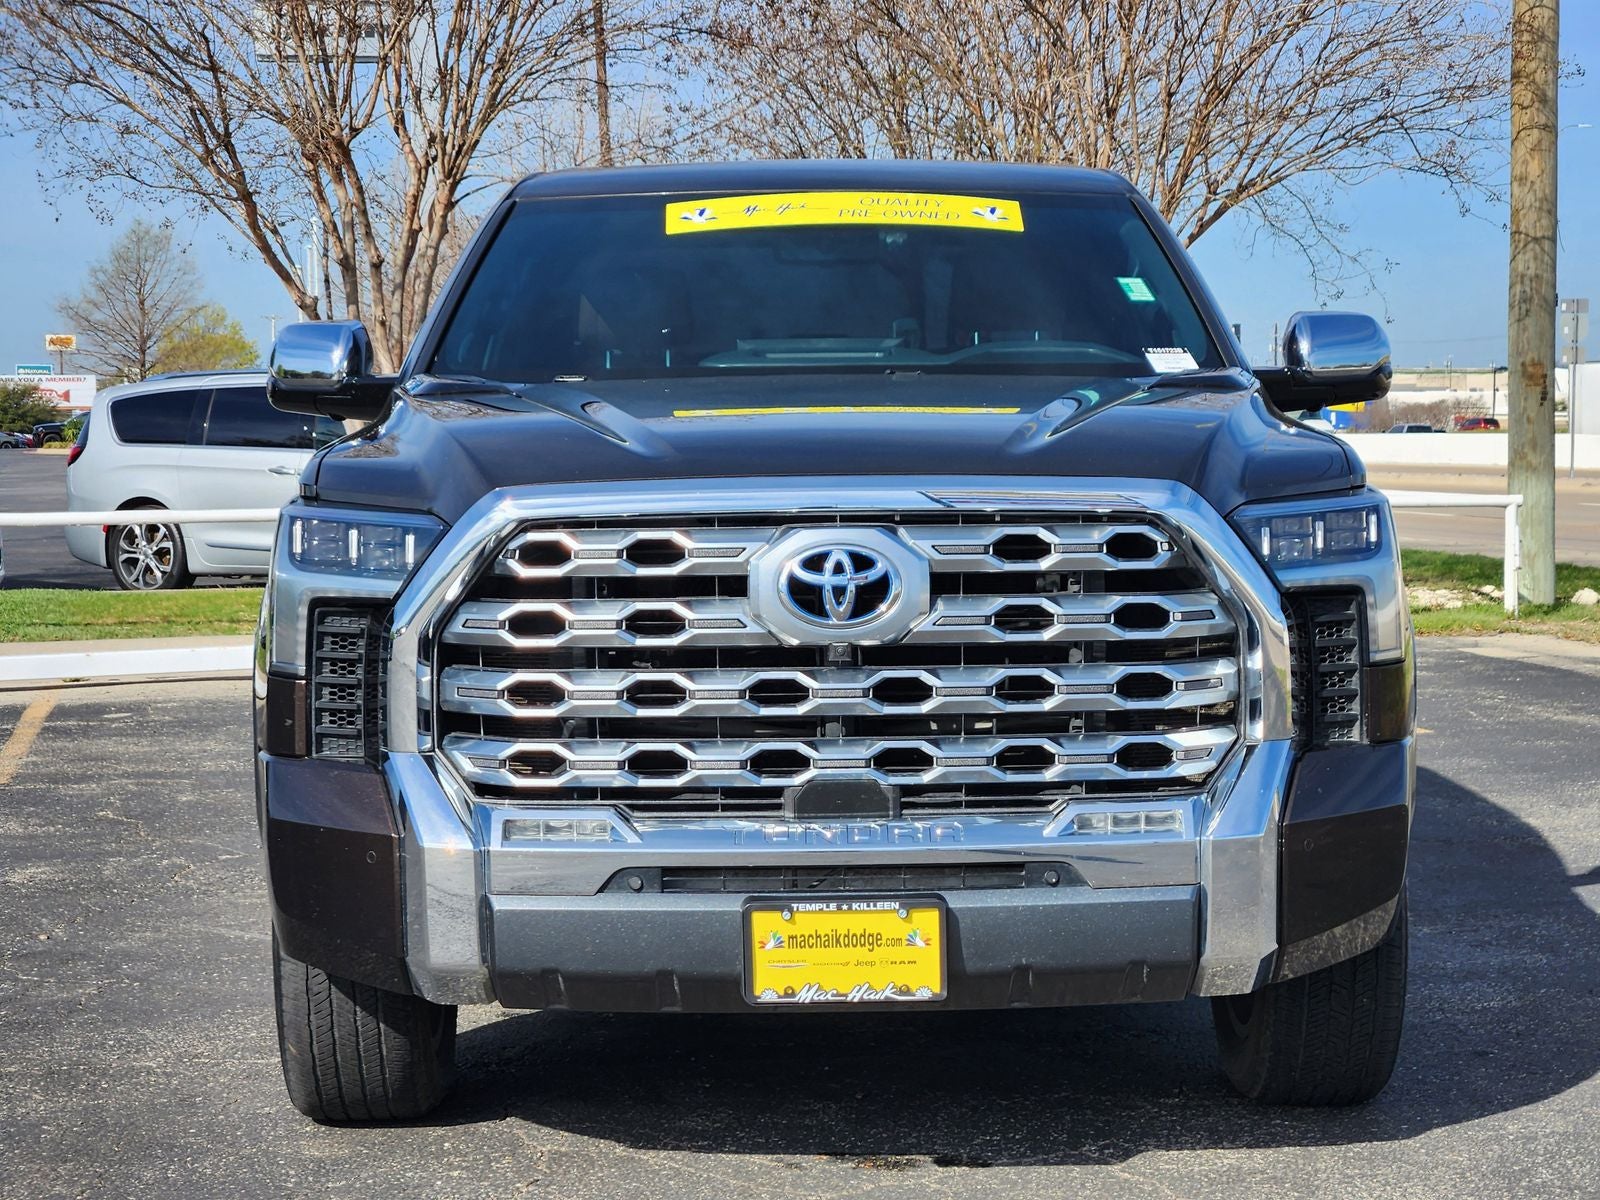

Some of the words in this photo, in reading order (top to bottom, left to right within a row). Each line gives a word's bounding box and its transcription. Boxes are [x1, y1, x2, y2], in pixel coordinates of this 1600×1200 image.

[859, 196, 945, 208] QUALITY
[838, 208, 961, 220] PRE-OWNED
[791, 903, 838, 911] TEMPLE
[852, 902, 900, 910] KILLEEN
[787, 929, 903, 953] machaikdodge.com
[853, 959, 876, 968] Jeep
[793, 983, 846, 1003] Mac
[846, 982, 908, 1001] Haik
